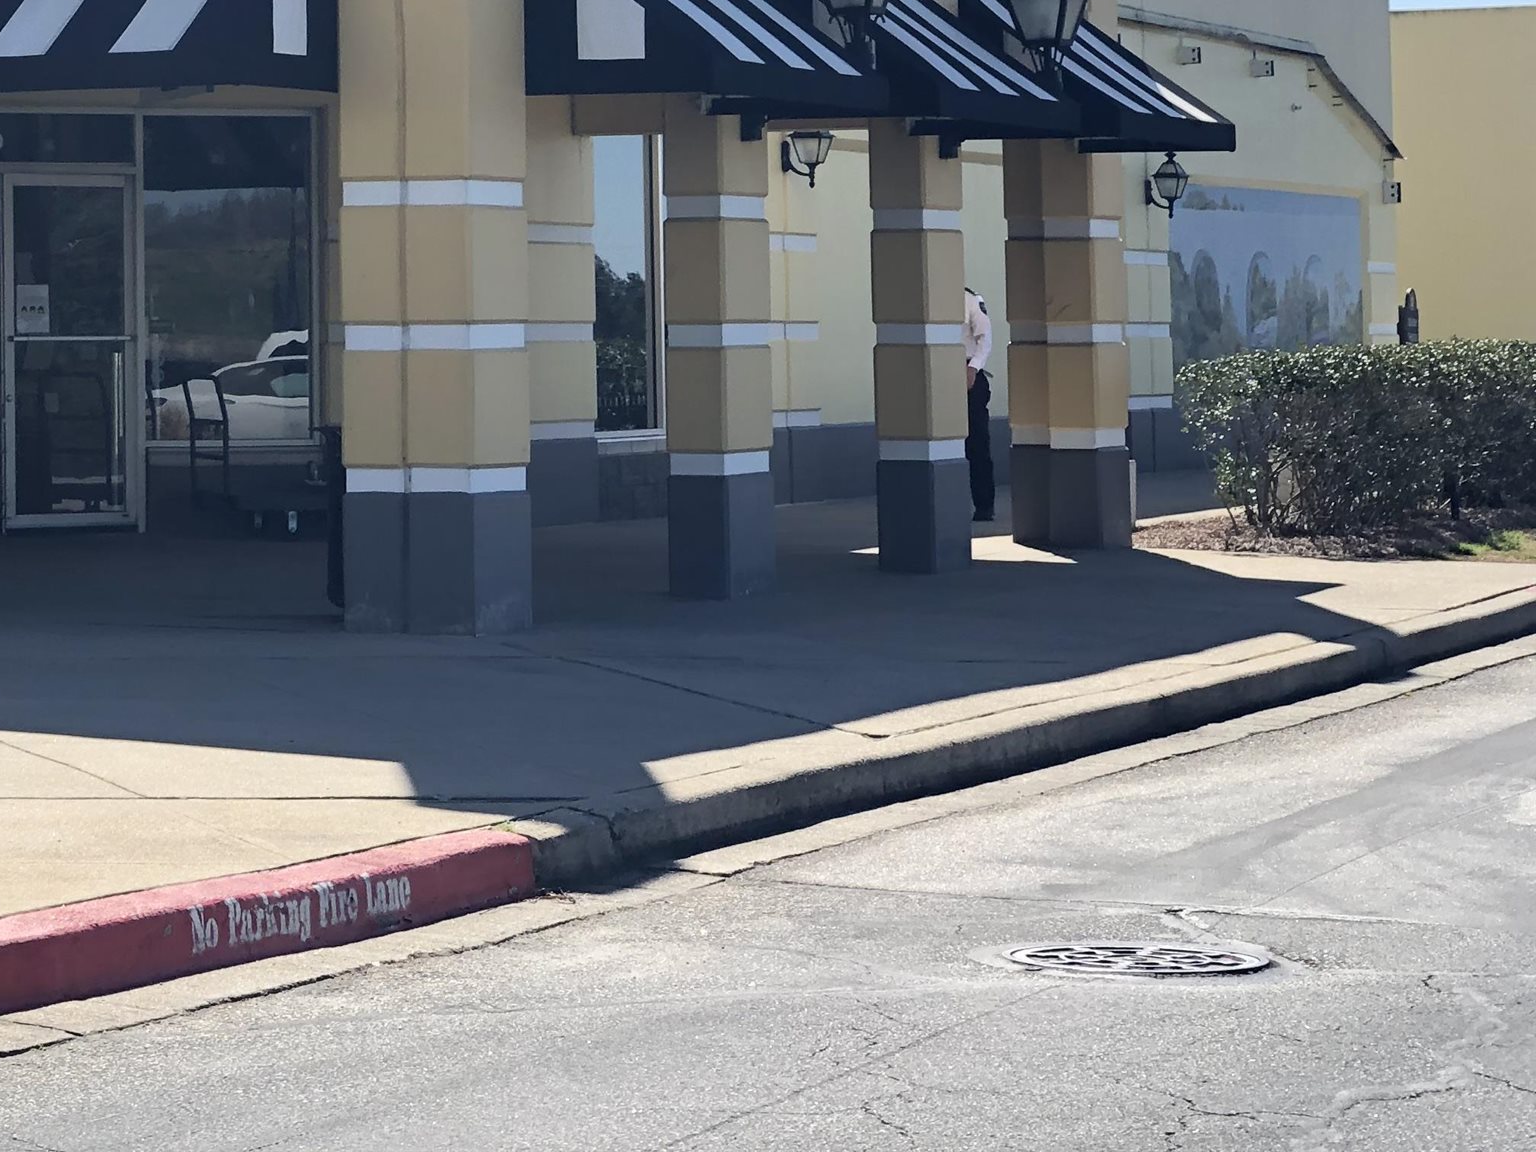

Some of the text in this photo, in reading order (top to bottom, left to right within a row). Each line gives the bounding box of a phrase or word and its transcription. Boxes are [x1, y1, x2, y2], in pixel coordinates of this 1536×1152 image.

[188, 872, 412, 954] No Parking Fire Lane
